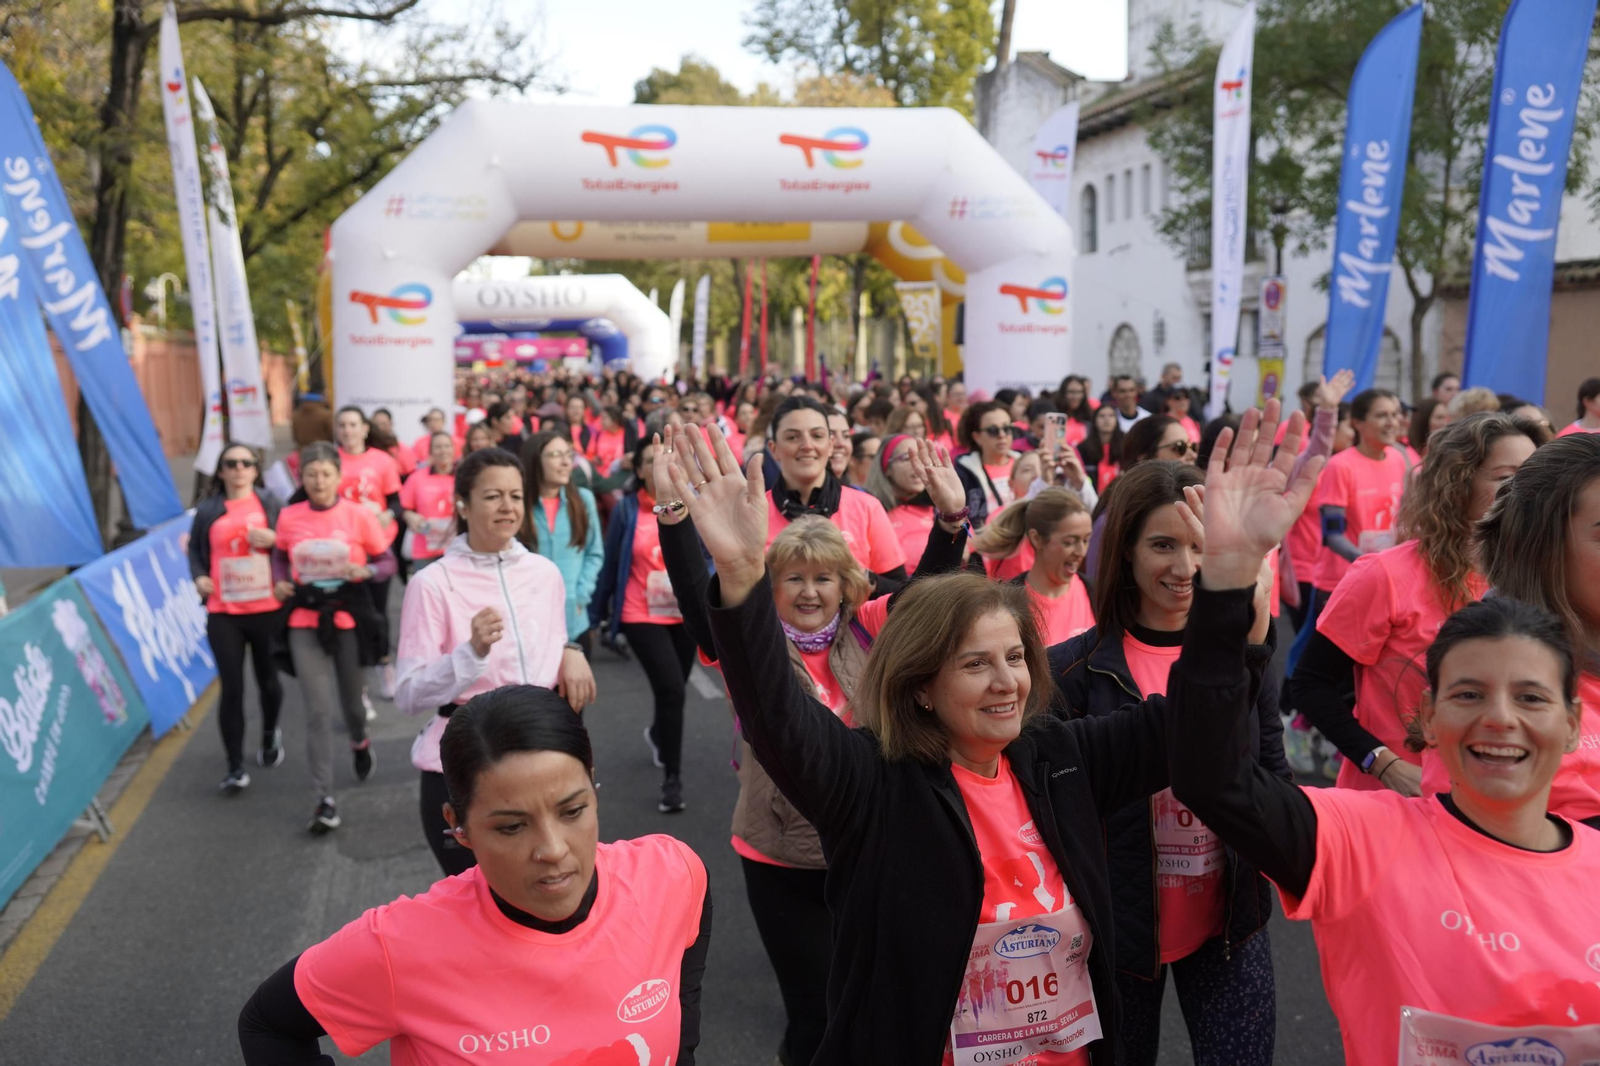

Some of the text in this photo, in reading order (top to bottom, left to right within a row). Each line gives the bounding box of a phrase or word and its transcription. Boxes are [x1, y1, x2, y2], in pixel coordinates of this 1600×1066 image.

[581, 177, 679, 193] TotalEnergies
[778, 177, 870, 193] TotalEnergies
[1482, 83, 1564, 281] Marlene
[1337, 139, 1392, 308] Marlene
[477, 285, 586, 309] OYSHO
[1193, 834, 1208, 844] 871
[1158, 858, 1190, 869] YSHO
[1006, 973, 1058, 1004] 016
[624, 987, 668, 1019] ASTURIANA
[977, 1031, 1012, 1043] CARRERA
[1014, 1029, 1024, 1038] DE
[1025, 1028, 1035, 1036] LA
[1060, 1010, 1079, 1026] SEVILLA
[1027, 1010, 1047, 1024] 872
[459, 1024, 551, 1054] OYSHO
[973, 1027, 1085, 1064] OYSHO Santander
[1417, 1044, 1458, 1059] SUMA
